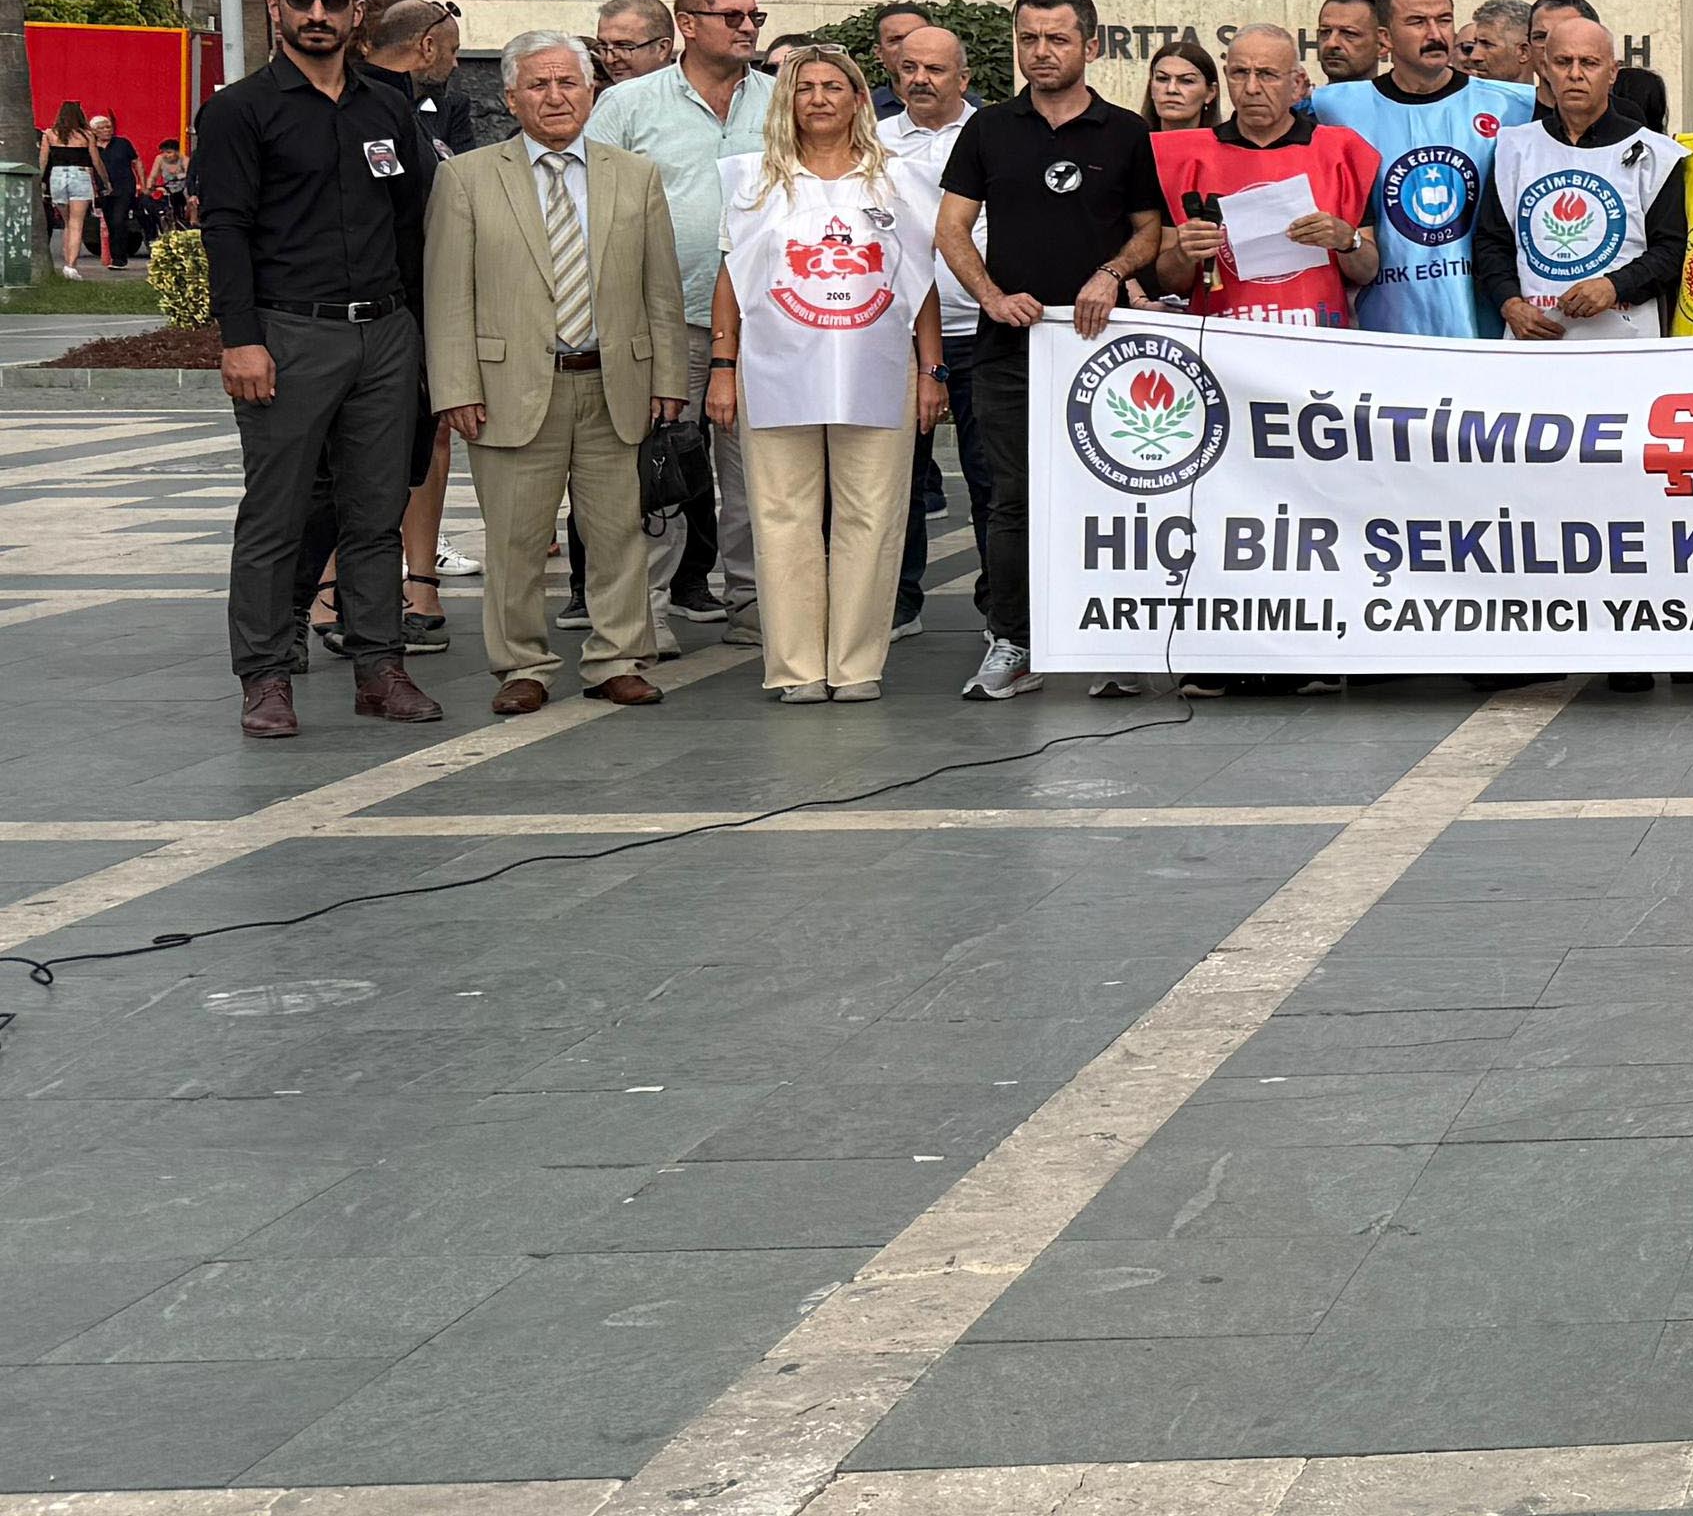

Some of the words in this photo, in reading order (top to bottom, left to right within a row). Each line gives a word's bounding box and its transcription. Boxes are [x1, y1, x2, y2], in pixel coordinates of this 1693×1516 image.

[1387, 166, 1409, 208] TÜRK
[1521, 174, 1621, 220] EĞİTİM-BİR-SEN
[1421, 228, 1455, 244] 1992
[826, 292, 851, 301] 2005
[1075, 339, 1220, 406] EĞİTİM-BİR-SEN
[1249, 389, 1628, 463] EĞİTİMDE
[1074, 422, 1129, 485] EĞİTİMCİLER
[1129, 471, 1178, 489] BİRLİĞİ
[1083, 502, 1197, 586] HİÇ
[1223, 503, 1340, 572] BİR
[1364, 506, 1648, 587] ŞEKİLDE
[1078, 596, 1347, 640] ARTTIRIMLI,
[1364, 598, 1588, 632] CAYDIRICI
